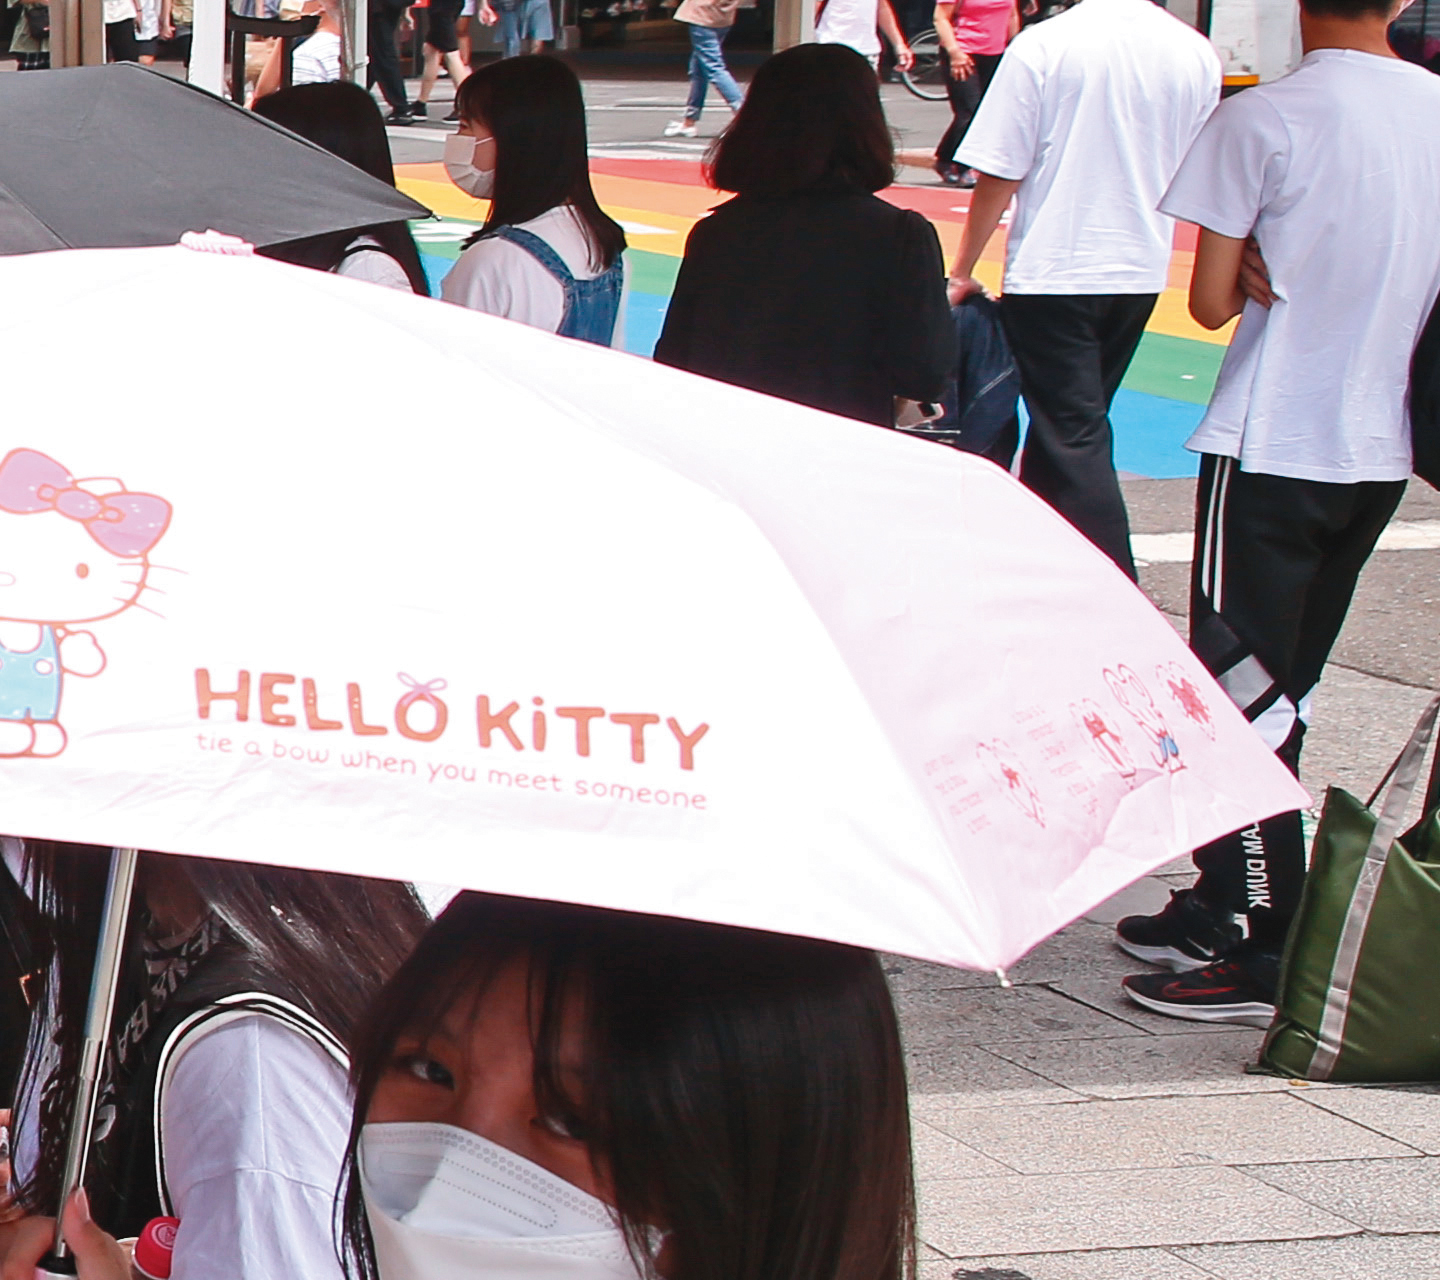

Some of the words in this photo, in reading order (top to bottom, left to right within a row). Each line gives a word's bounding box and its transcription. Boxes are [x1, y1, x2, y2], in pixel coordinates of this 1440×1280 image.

[195, 668, 448, 743] HELLO
[195, 733, 233, 753] tie
[243, 736, 263, 758] a
[272, 737, 330, 765] bow
[340, 749, 417, 776] when
[426, 761, 477, 785] you
[487, 770, 563, 792] meet
[574, 778, 708, 810] someone
